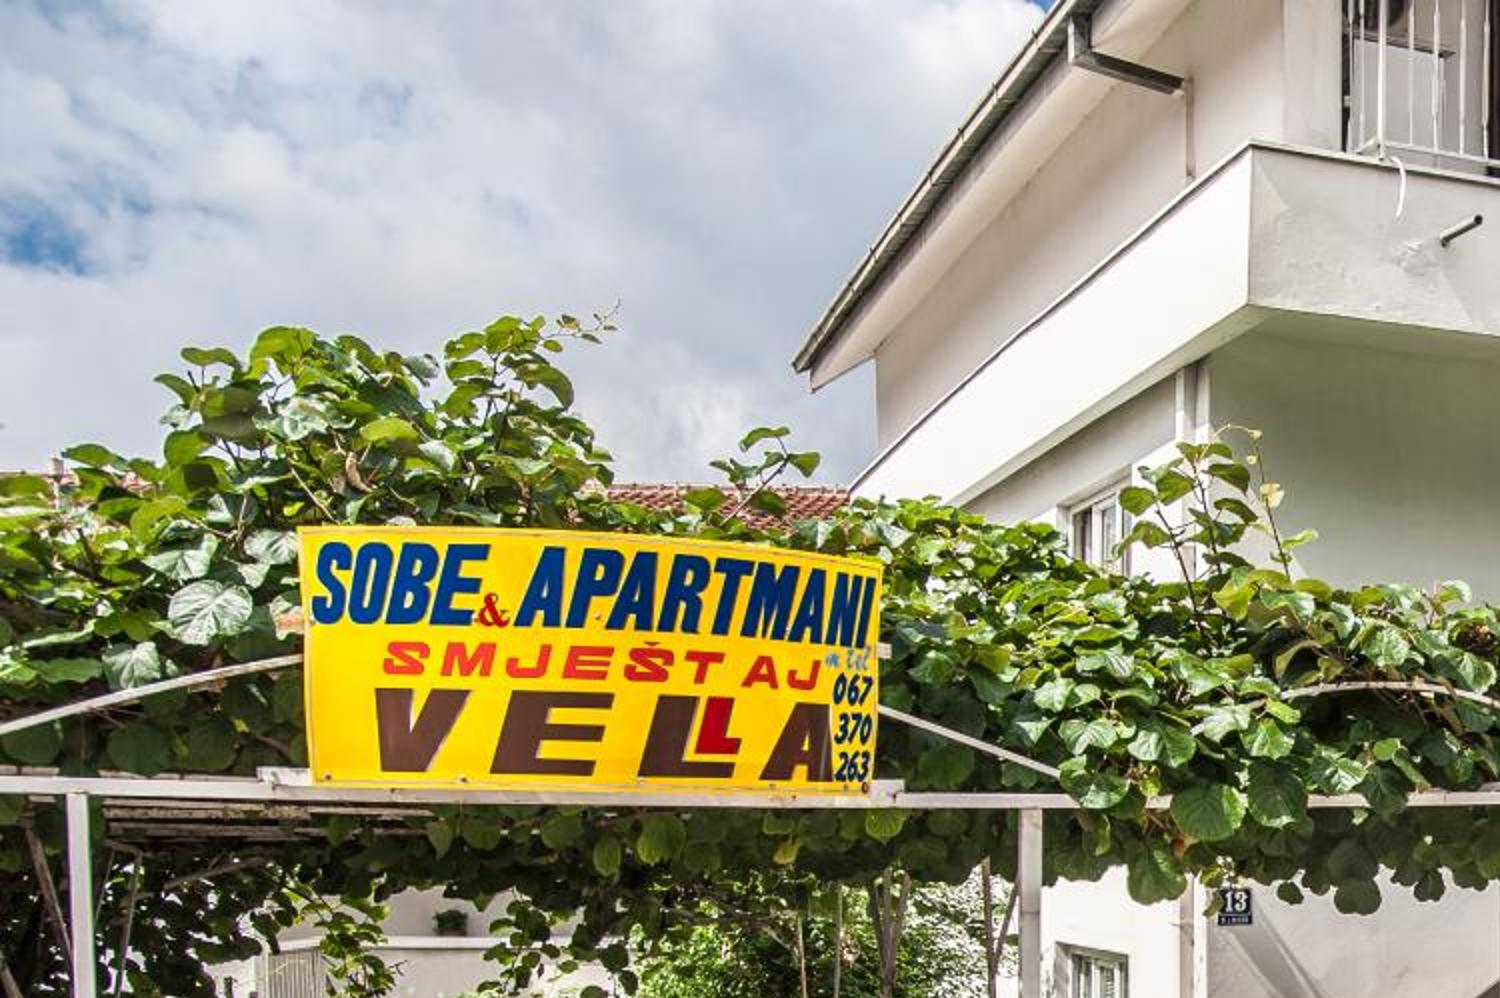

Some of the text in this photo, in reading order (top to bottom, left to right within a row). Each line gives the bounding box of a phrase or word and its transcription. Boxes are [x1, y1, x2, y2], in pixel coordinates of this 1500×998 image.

[312, 541, 877, 648] SOBE & APARTMANI
[383, 641, 821, 691] SMJEŠTAJ
[833, 672, 874, 706] 067
[834, 712, 873, 746] 370
[833, 751, 871, 783] 263
[1225, 891, 1248, 912] 13
